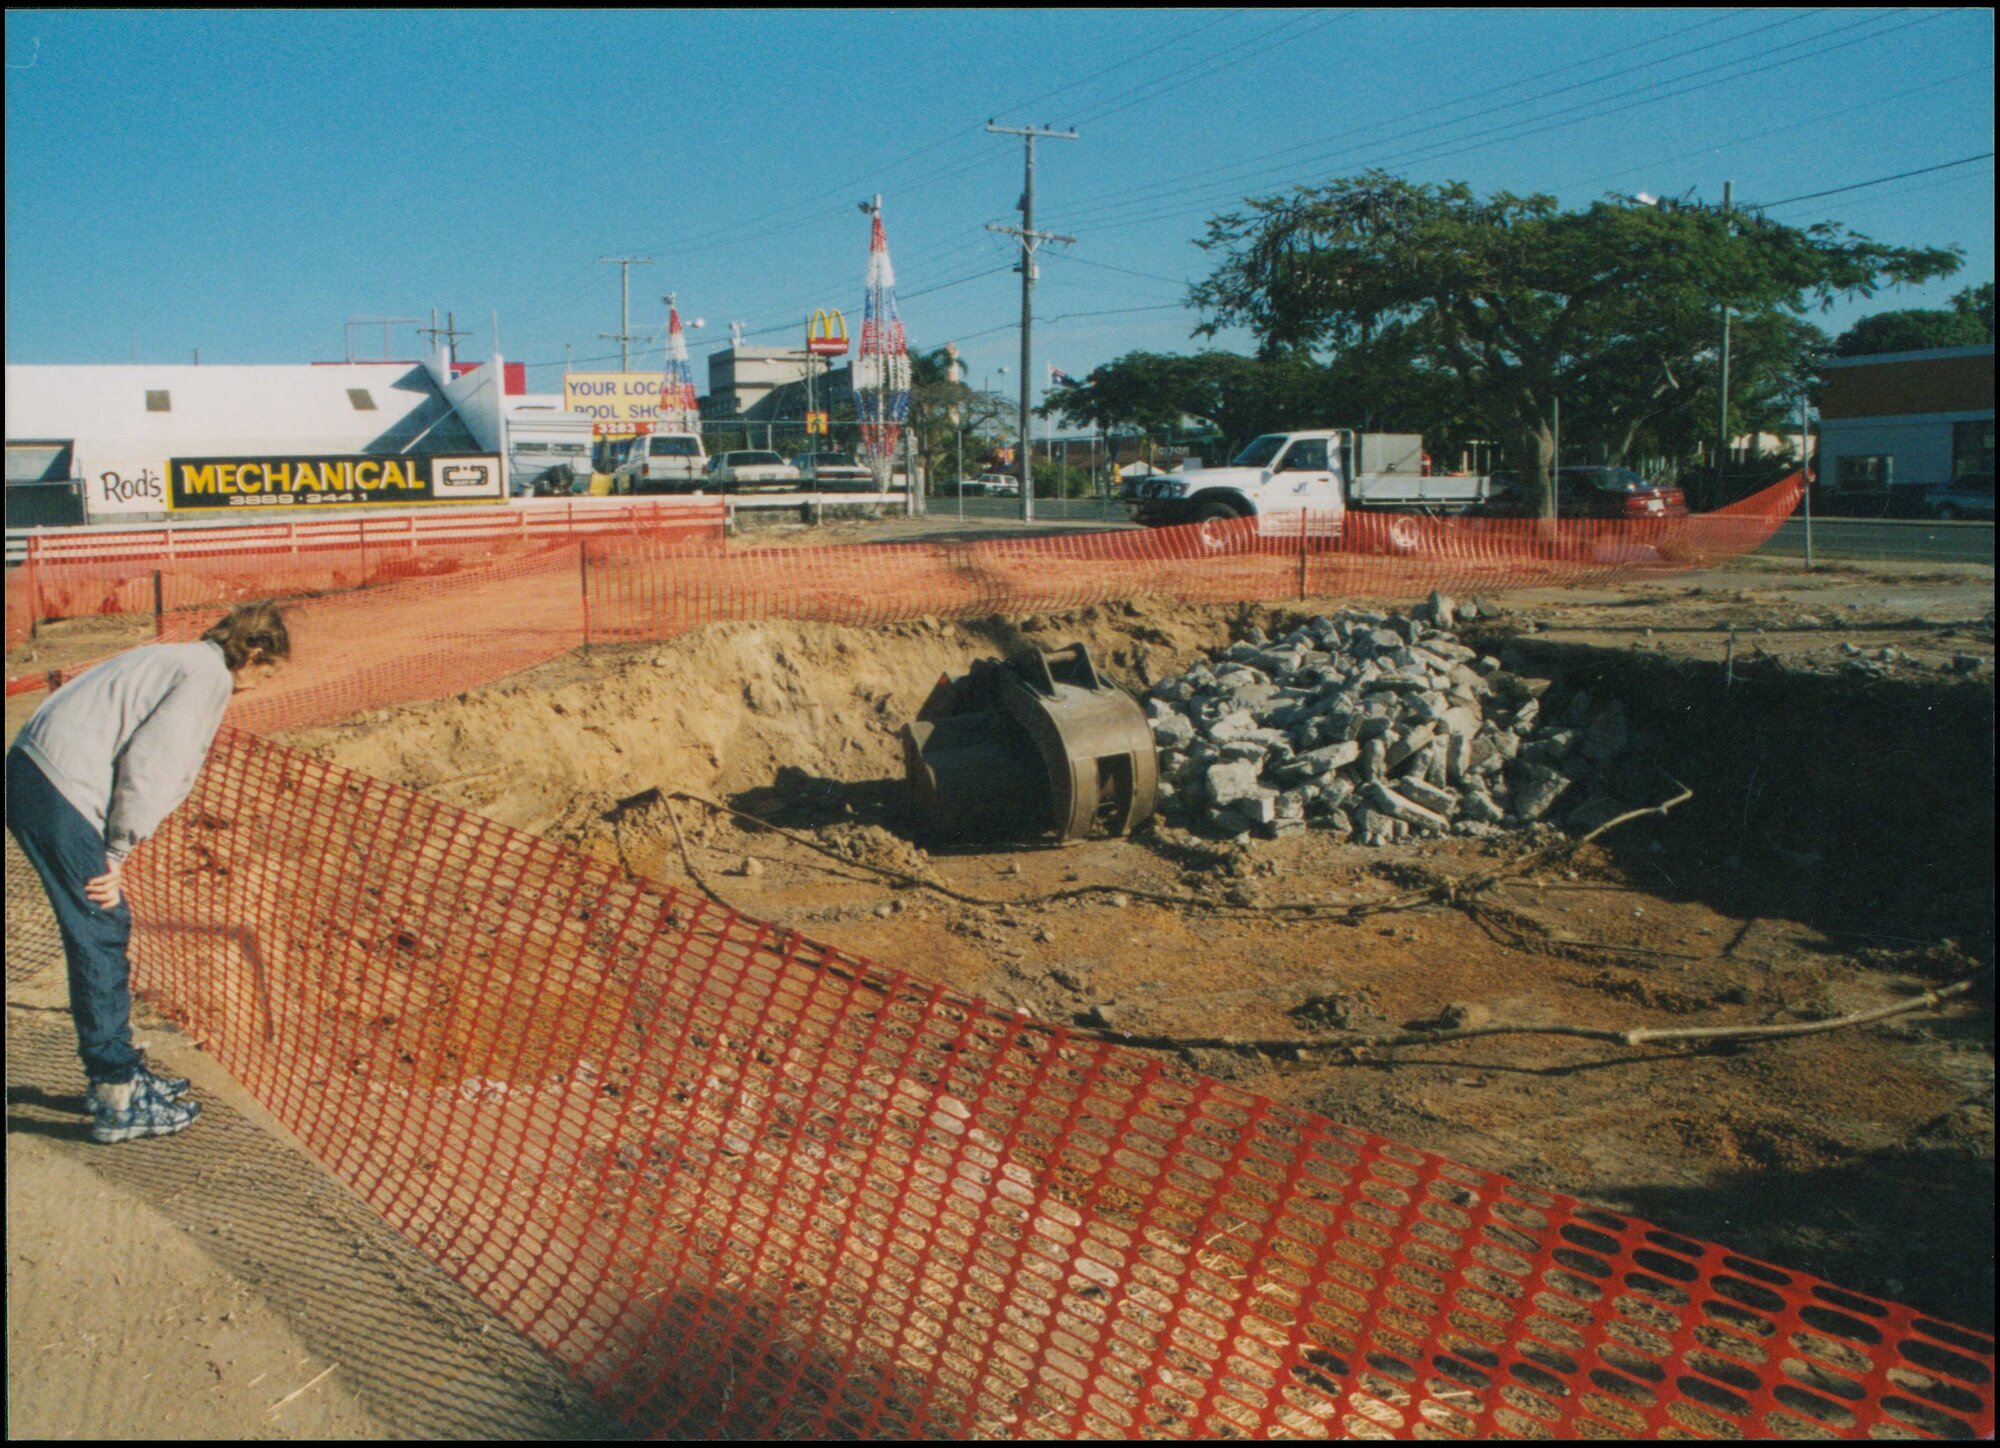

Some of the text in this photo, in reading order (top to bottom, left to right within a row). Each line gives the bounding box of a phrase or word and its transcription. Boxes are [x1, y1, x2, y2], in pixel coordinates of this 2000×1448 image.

[568, 381, 617, 396] YOUR
[574, 404, 670, 419] POOL SHO
[100, 461, 425, 503] Rod's MECHANICAL
